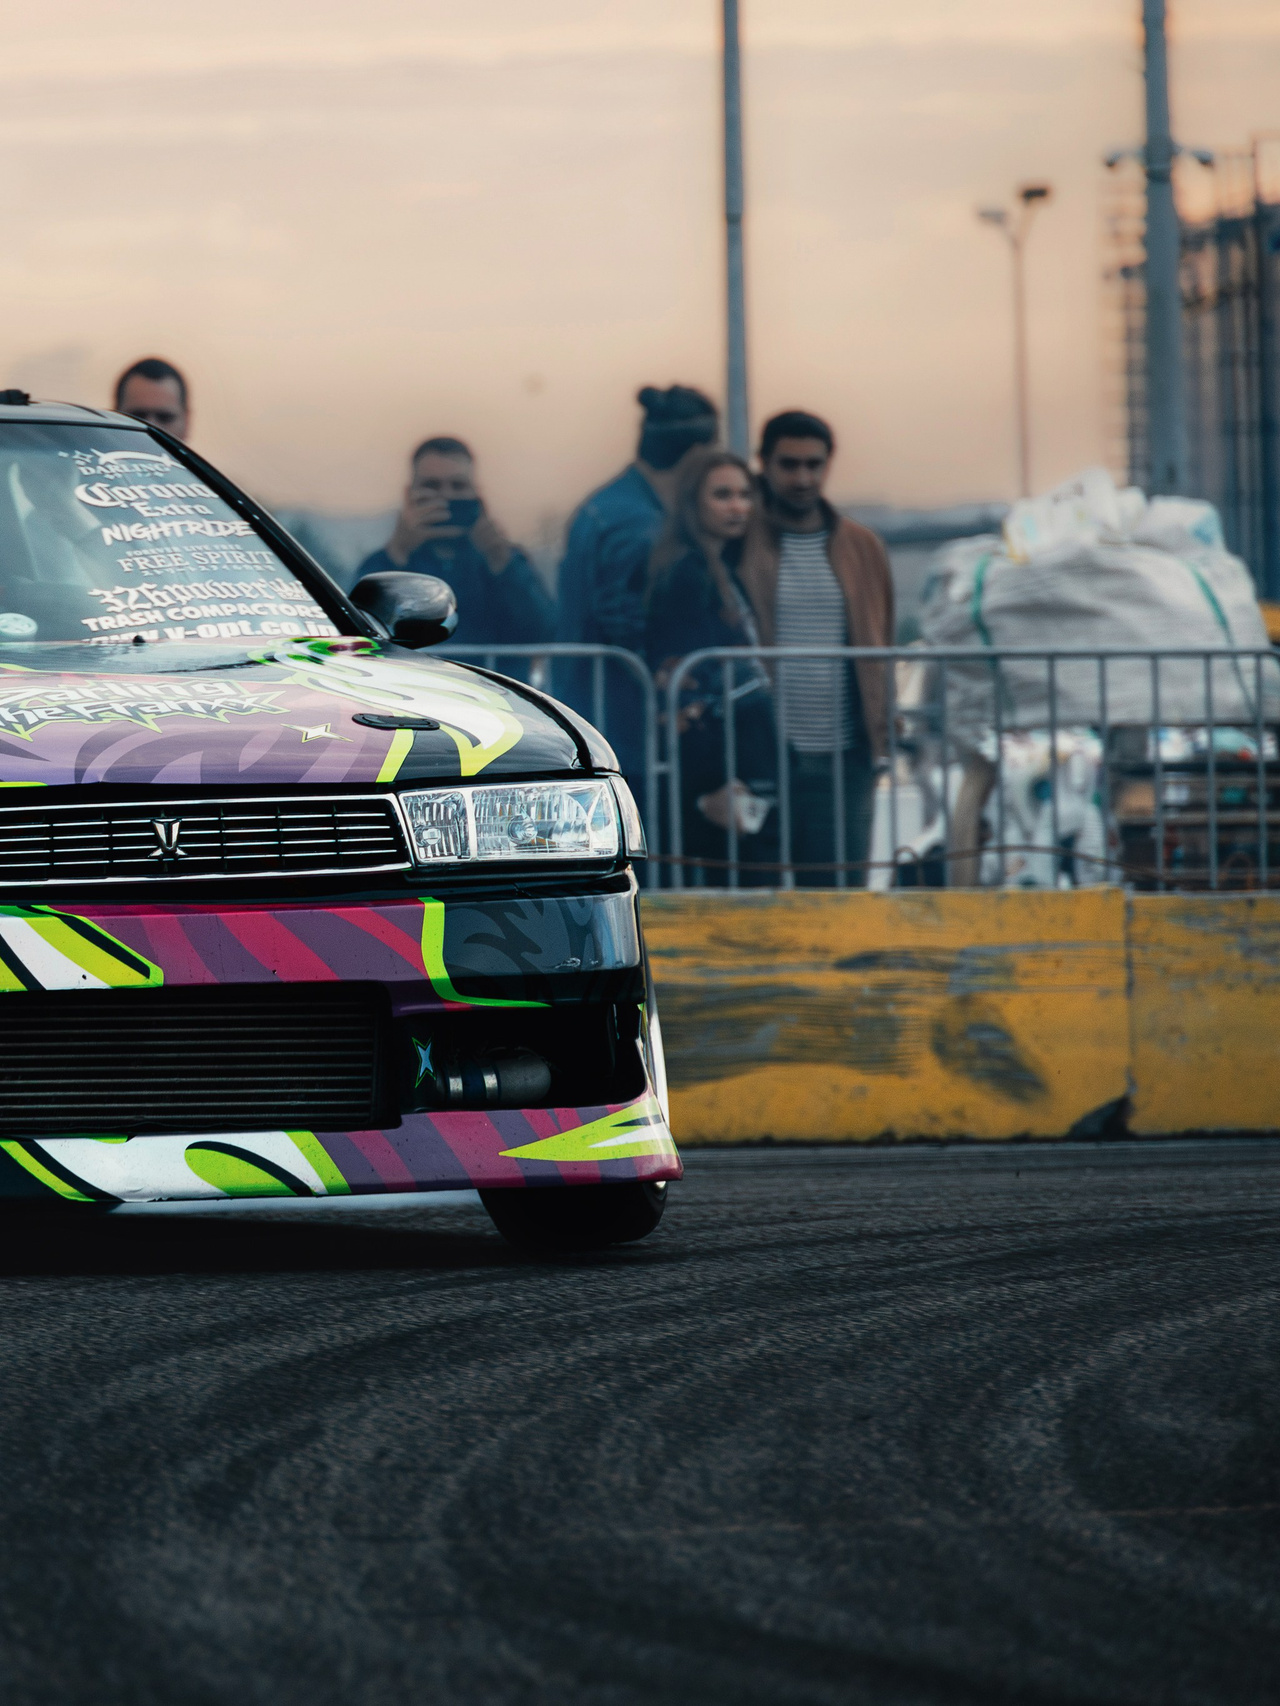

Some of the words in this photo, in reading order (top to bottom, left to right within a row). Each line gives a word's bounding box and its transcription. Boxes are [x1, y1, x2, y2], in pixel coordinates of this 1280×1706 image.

[74, 482, 219, 508] Corona
[131, 502, 214, 517] Extra
[117, 553, 190, 572] FREE
[191, 550, 275, 565] SPIRIT
[81, 609, 165, 632] TRASH
[167, 602, 328, 621] COMPACTORS
